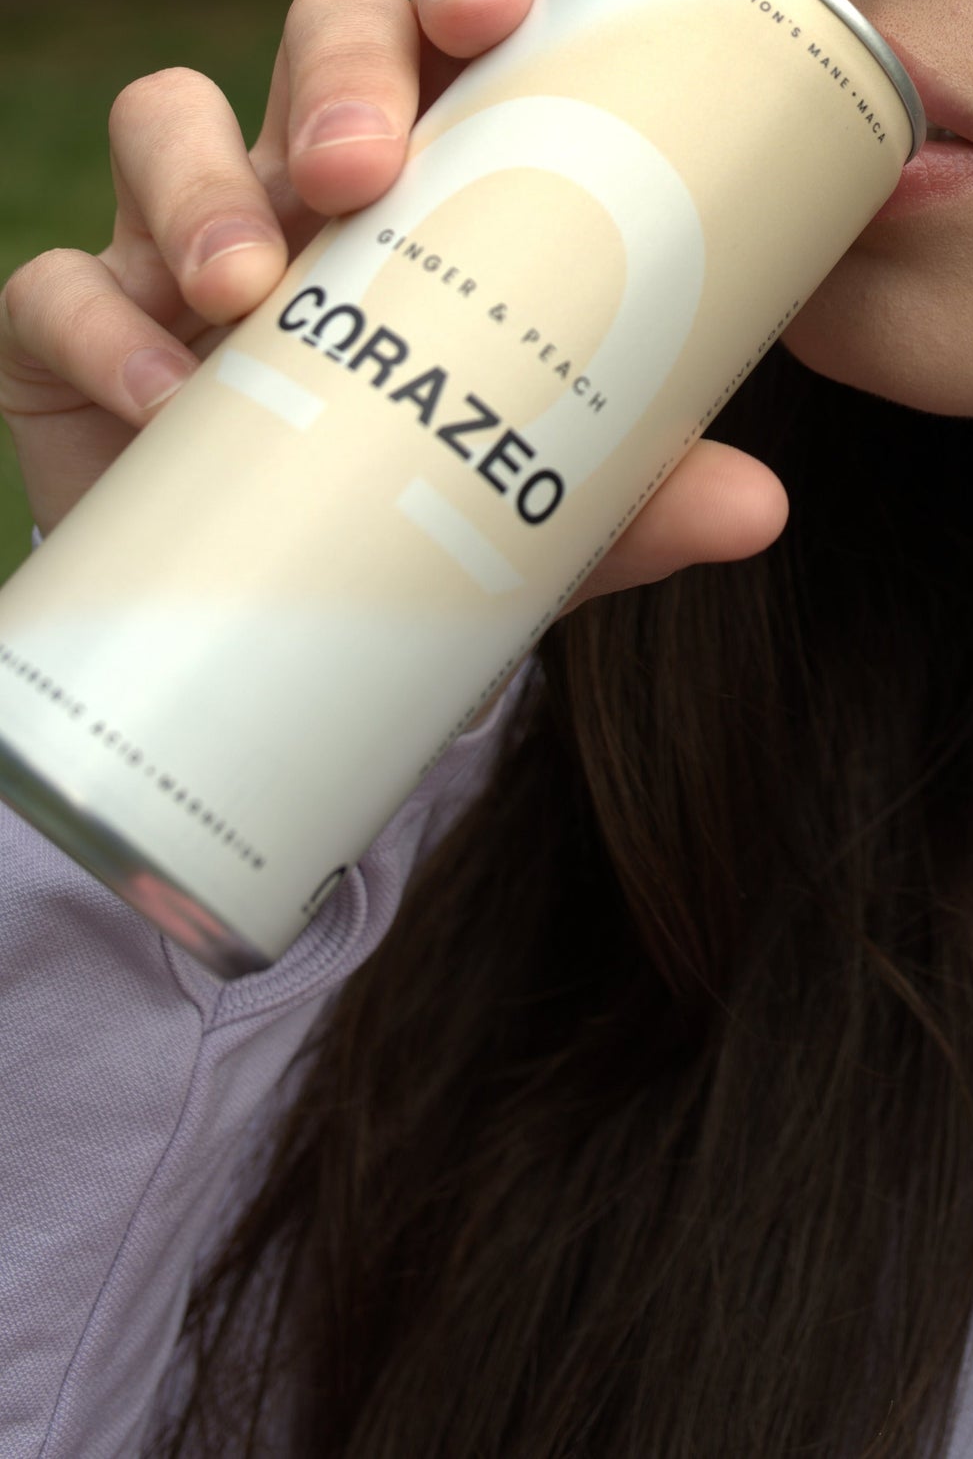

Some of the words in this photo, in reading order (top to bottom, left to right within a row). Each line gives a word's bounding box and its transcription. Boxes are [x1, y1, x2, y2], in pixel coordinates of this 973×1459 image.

[807, 42, 850, 89] MANE
[856, 98, 887, 144] MACA
[376, 228, 478, 299] GINGER
[487, 302, 509, 324] &
[520, 327, 608, 413] PEACH
